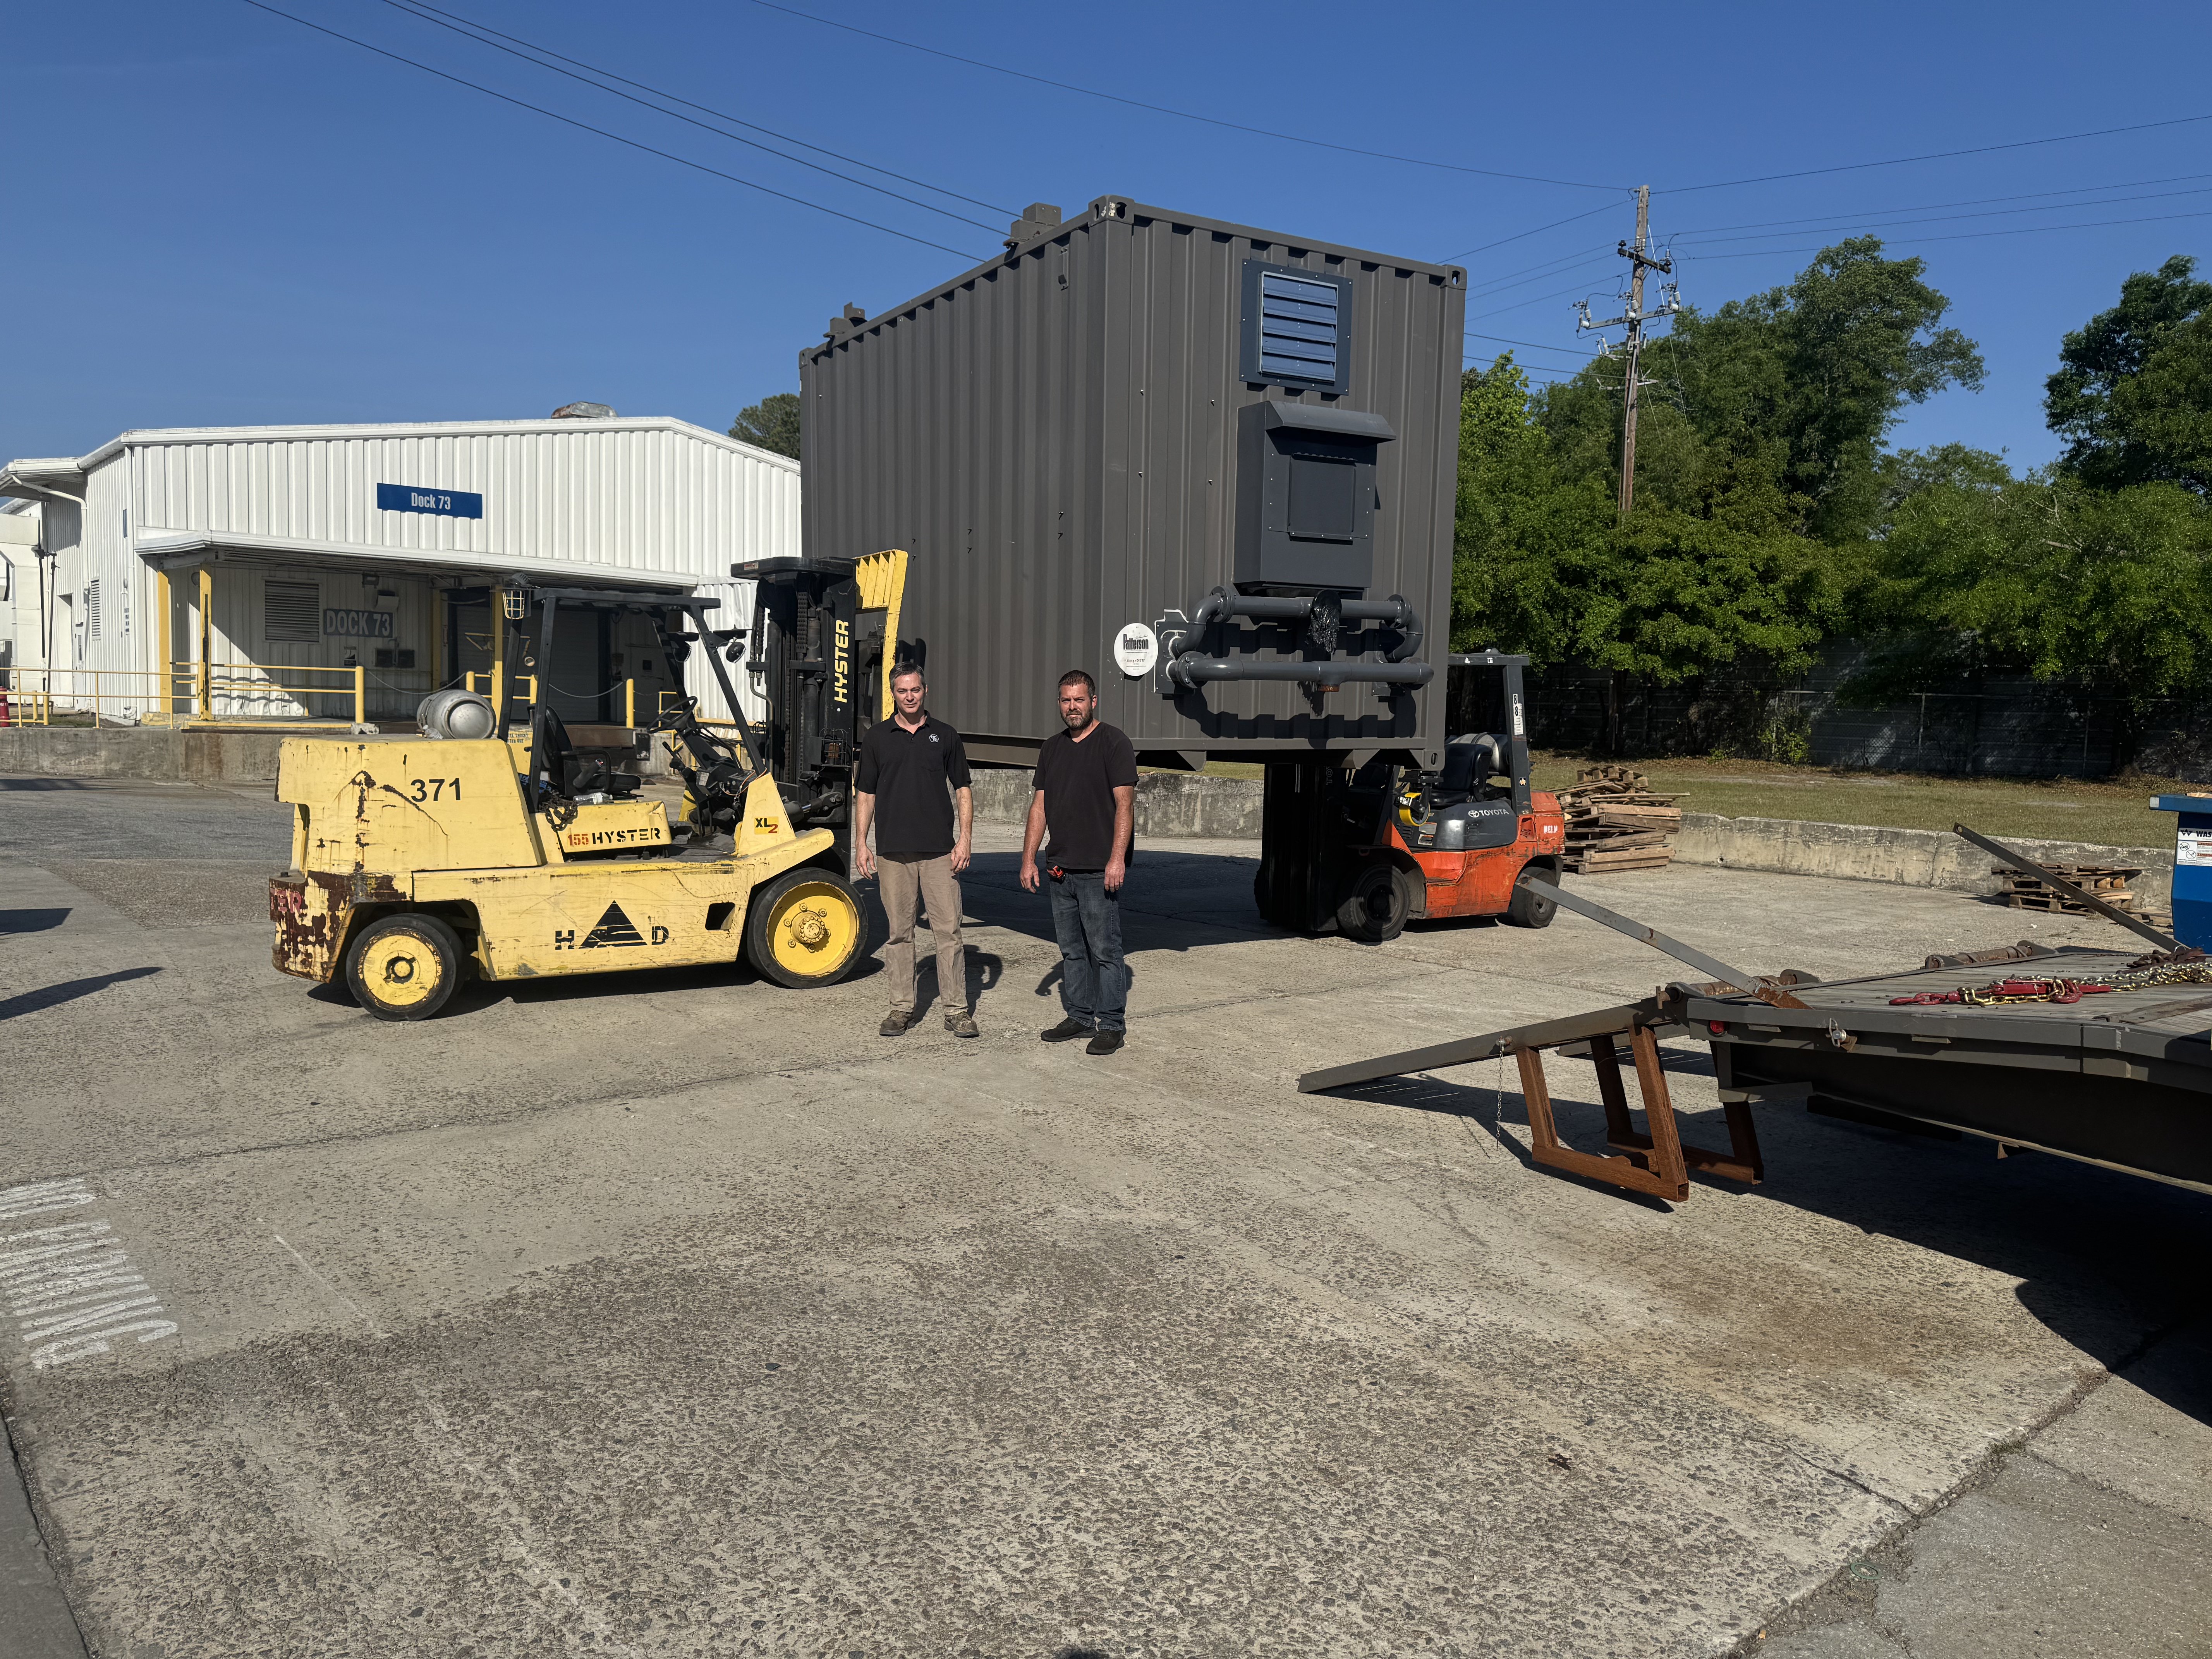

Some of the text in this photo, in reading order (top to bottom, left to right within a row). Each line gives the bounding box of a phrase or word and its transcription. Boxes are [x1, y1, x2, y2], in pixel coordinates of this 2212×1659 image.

[411, 492, 451, 510] Dock 73
[326, 610, 390, 636] DOCK 73
[1123, 634, 1149, 650] Patterson
[834, 620, 849, 703] HYSTER
[410, 778, 460, 802] 371
[568, 828, 661, 846] 155 HYSTER
